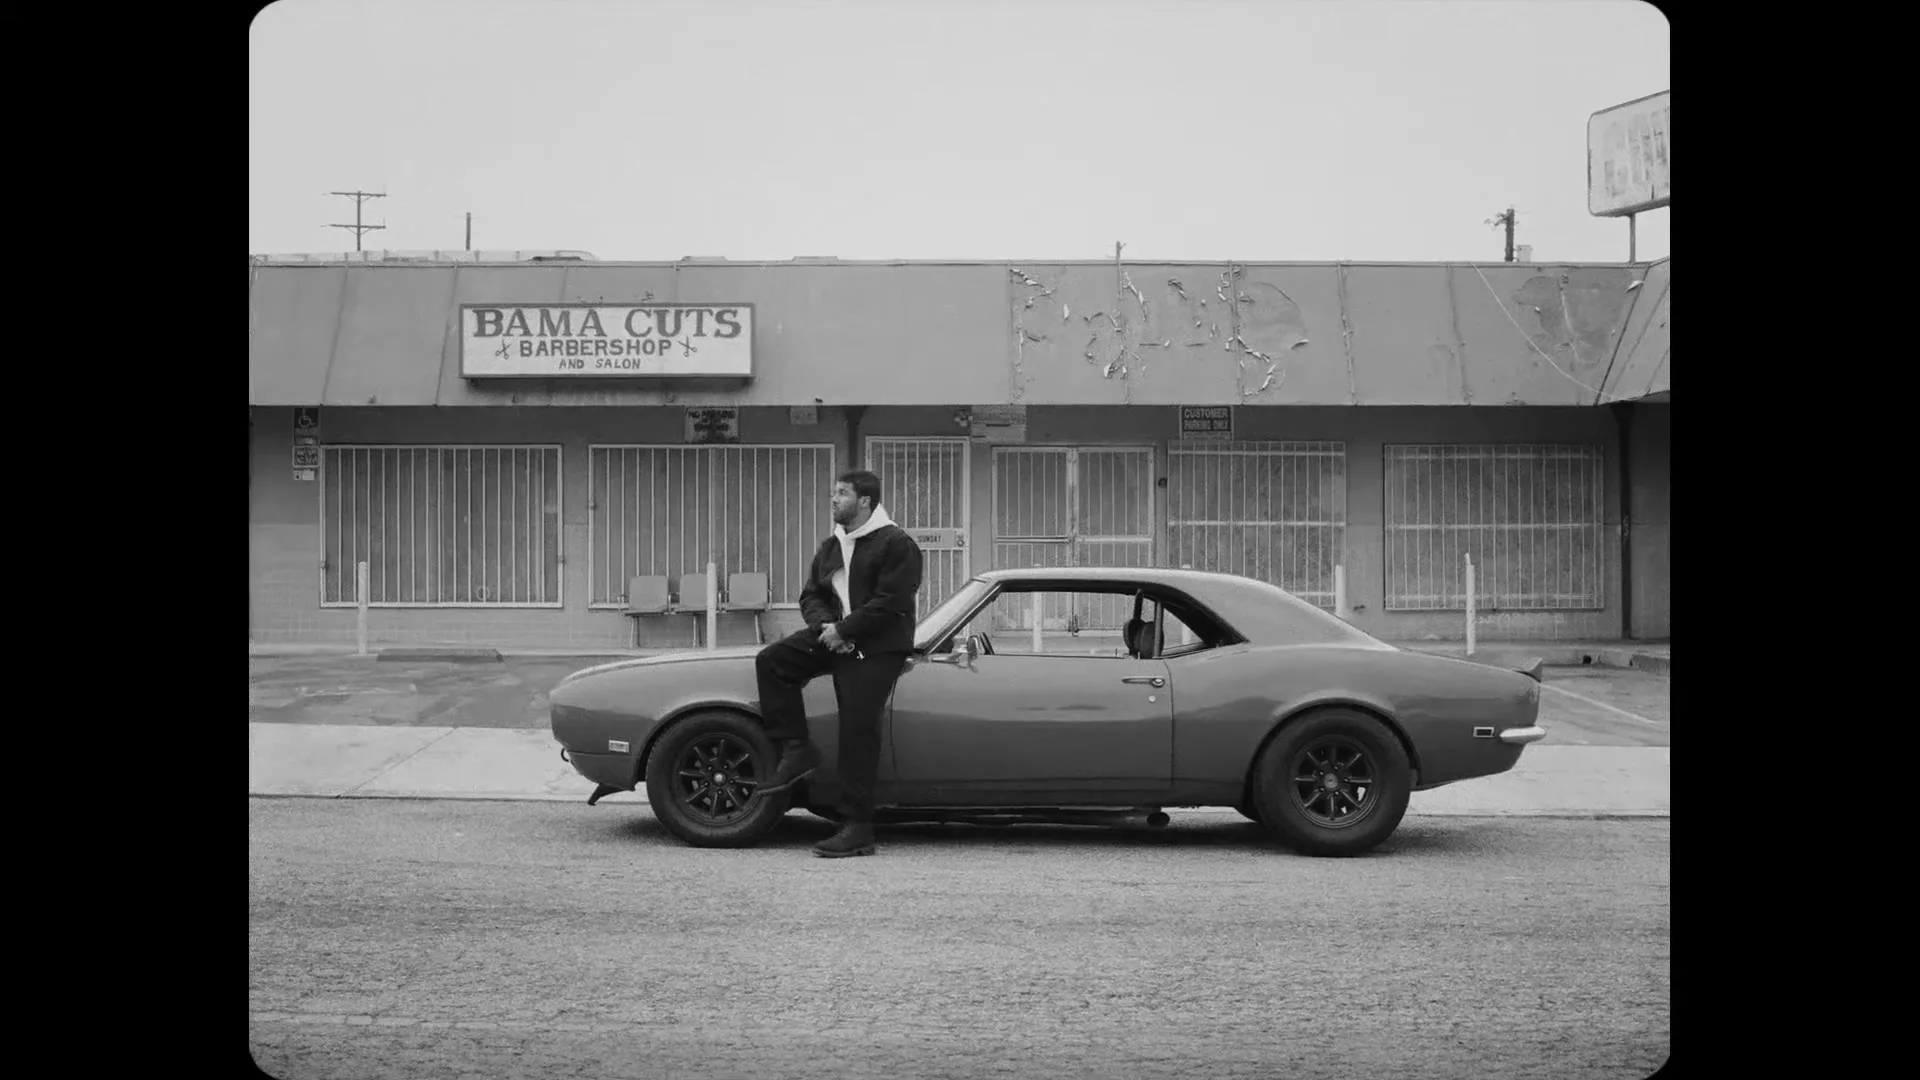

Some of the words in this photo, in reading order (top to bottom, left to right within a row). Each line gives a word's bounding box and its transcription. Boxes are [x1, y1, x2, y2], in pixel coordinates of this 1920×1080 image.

[473, 309, 608, 337] BAMA
[624, 309, 741, 338] CUTS
[519, 340, 672, 357] BARBERSHOP
[559, 359, 584, 369] AND
[595, 359, 641, 369] SALON
[1183, 407, 1229, 419] CUSTOMER
